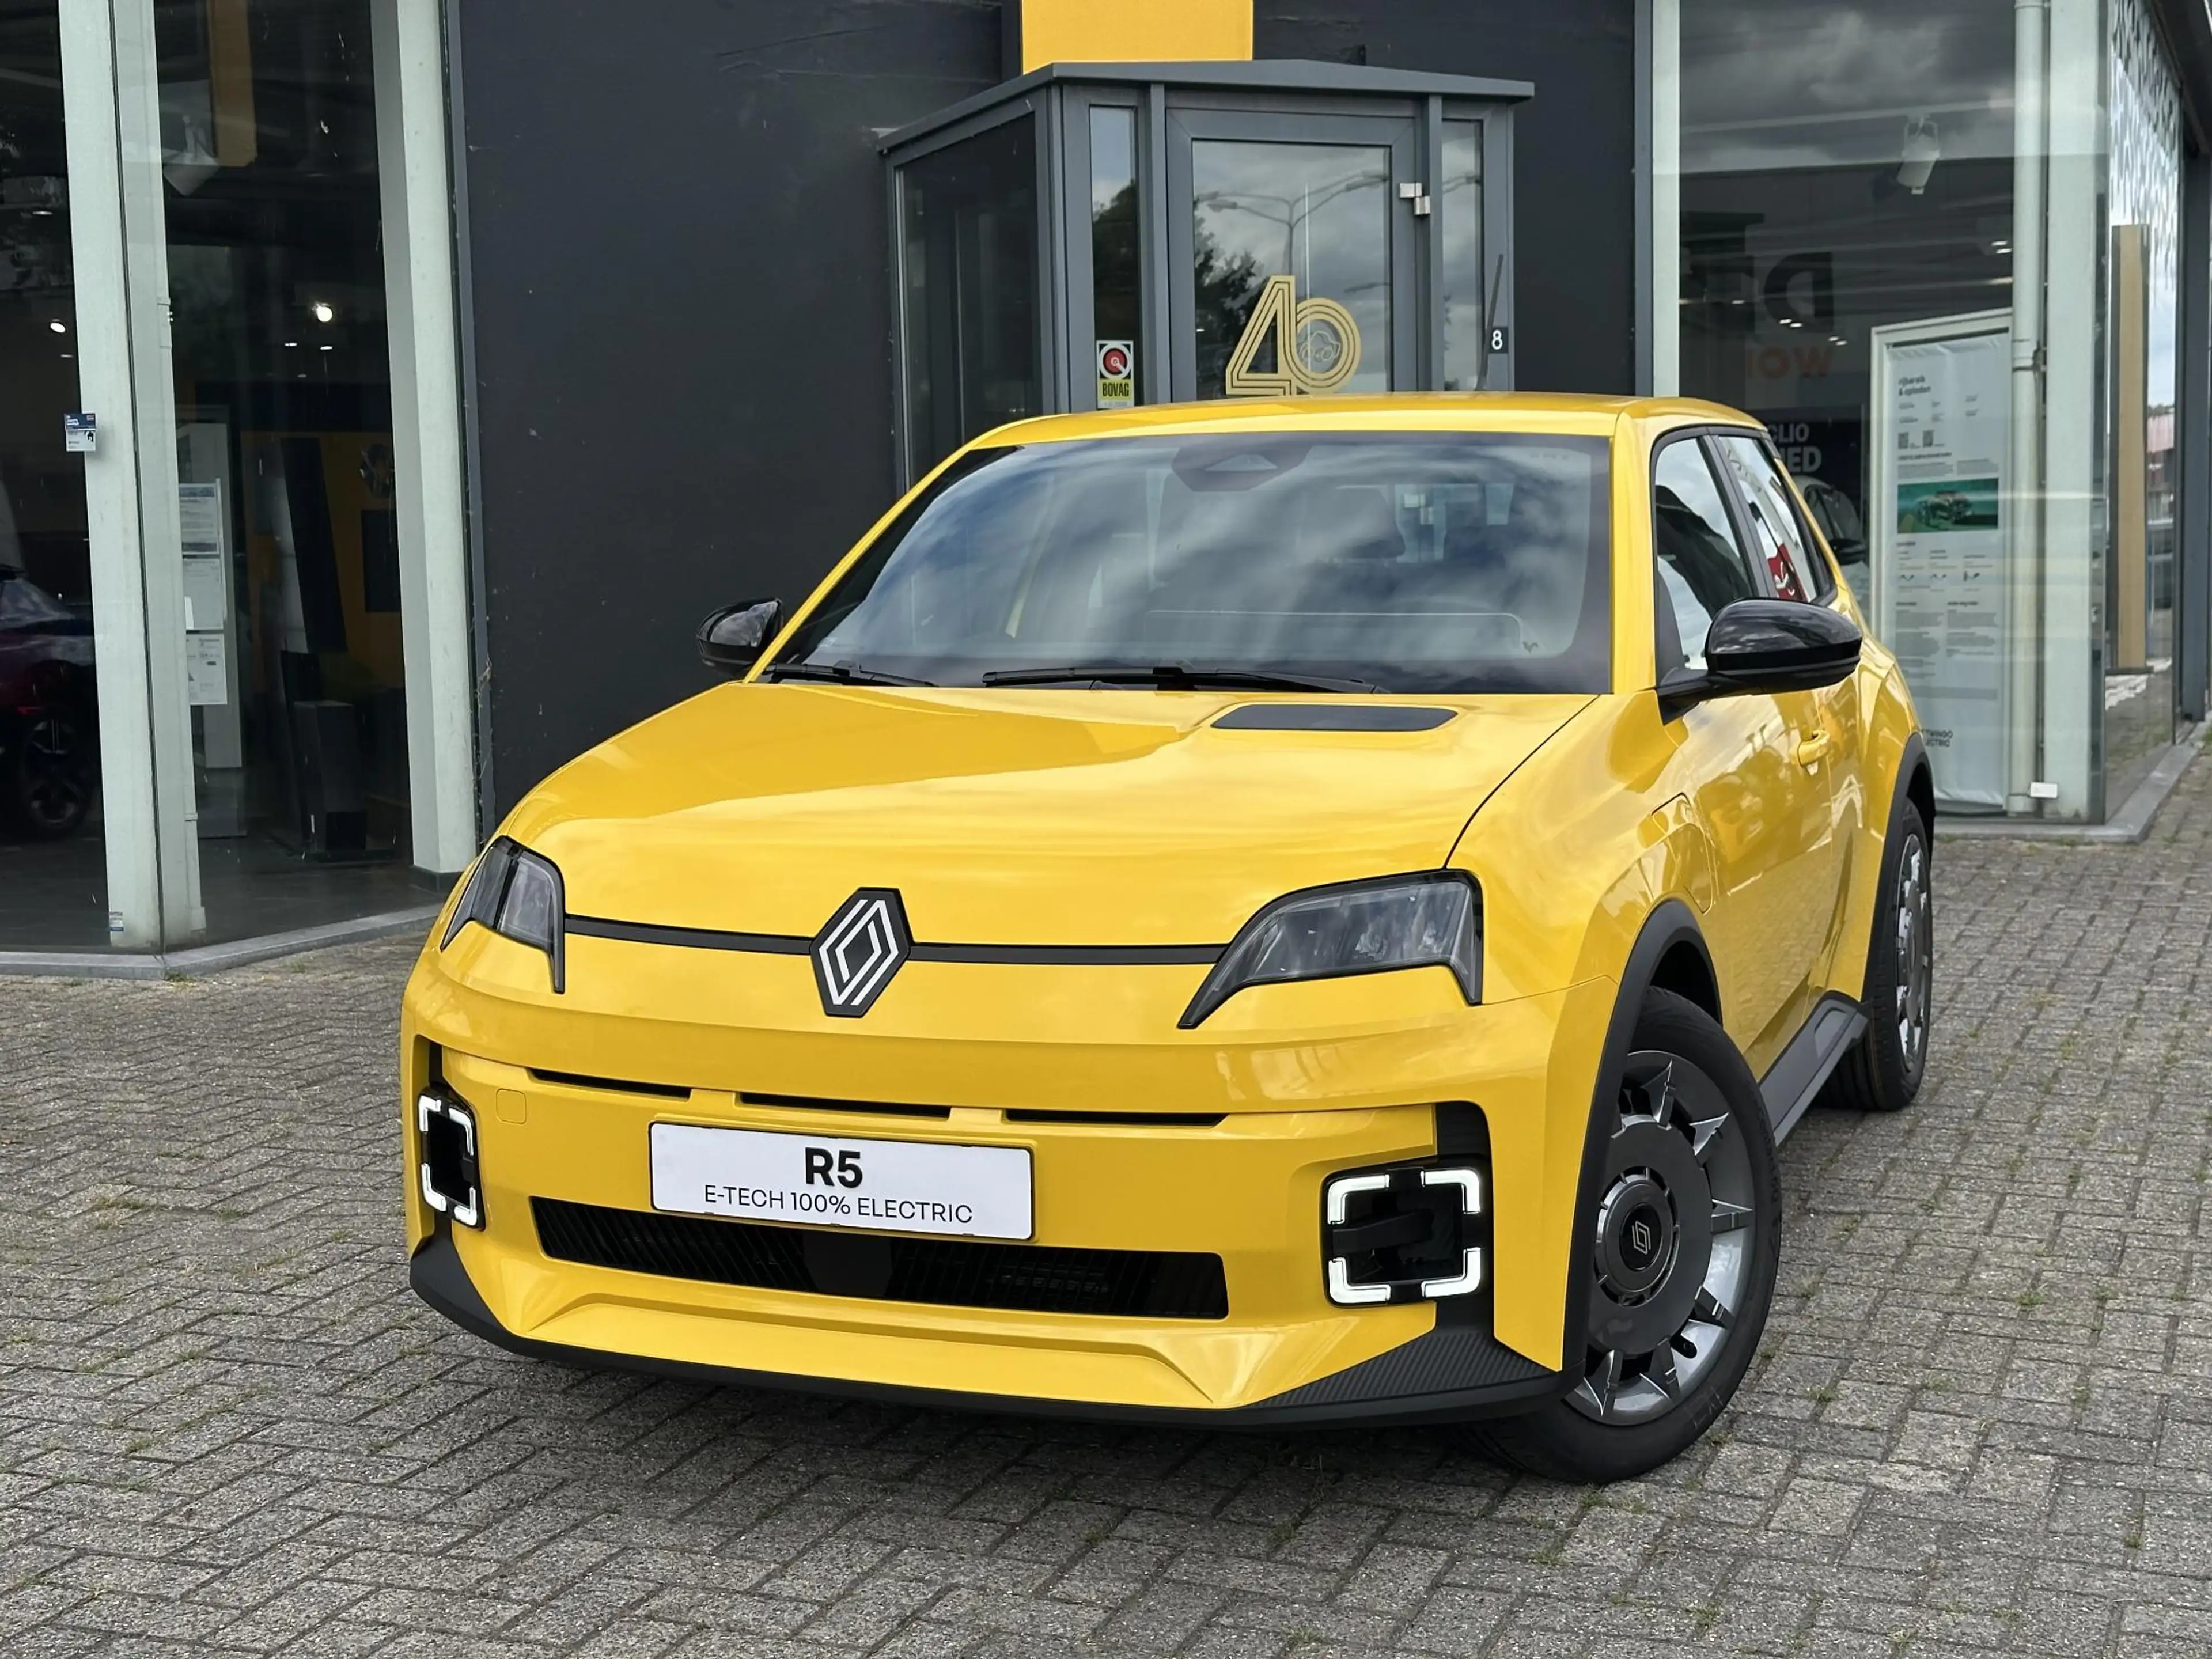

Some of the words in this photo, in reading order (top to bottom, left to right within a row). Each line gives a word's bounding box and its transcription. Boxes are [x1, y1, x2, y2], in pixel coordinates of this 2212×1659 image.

[1491, 329, 1503, 350] 8
[1102, 382, 1130, 397] BOVAG
[805, 1147, 863, 1188] R5
[704, 1184, 784, 1209] E-TECH
[790, 1191, 851, 1215] 100%
[857, 1197, 974, 1224] ELECTRIC
